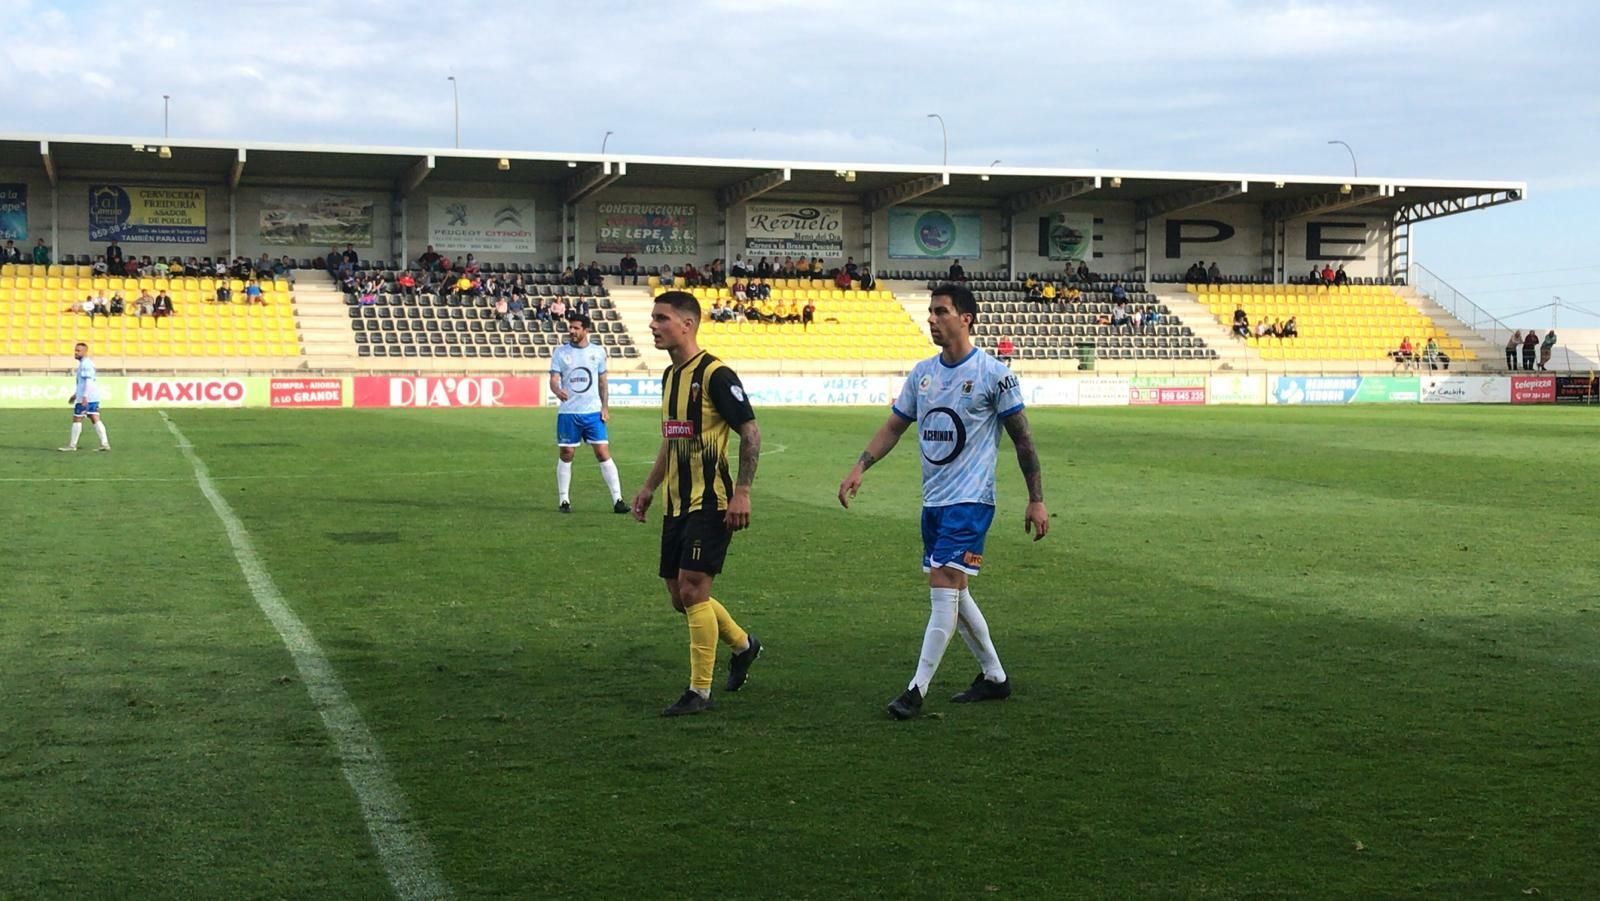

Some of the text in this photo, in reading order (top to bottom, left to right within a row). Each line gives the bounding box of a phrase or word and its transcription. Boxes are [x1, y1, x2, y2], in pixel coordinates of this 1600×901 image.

[140, 189, 201, 200] CERVECERÍA
[143, 198, 197, 209] FREIDURÍA
[153, 209, 187, 217] ASADOR
[599, 204, 696, 216] CONSTRUCCIONES
[161, 217, 192, 225] POLLOS
[751, 214, 839, 232] Revuelo
[121, 233, 155, 242] TAMBIÉN
[177, 235, 207, 243] LLEVAR
[600, 227, 694, 241] DE LEPE, S.L.
[272, 382, 305, 390] COMPRA
[1514, 379, 1552, 391] telepizza
[131, 382, 244, 401] MAXICO
[294, 391, 340, 402] GRANDE
[664, 422, 692, 437] jamón
[922, 430, 954, 442] ACERINOX
